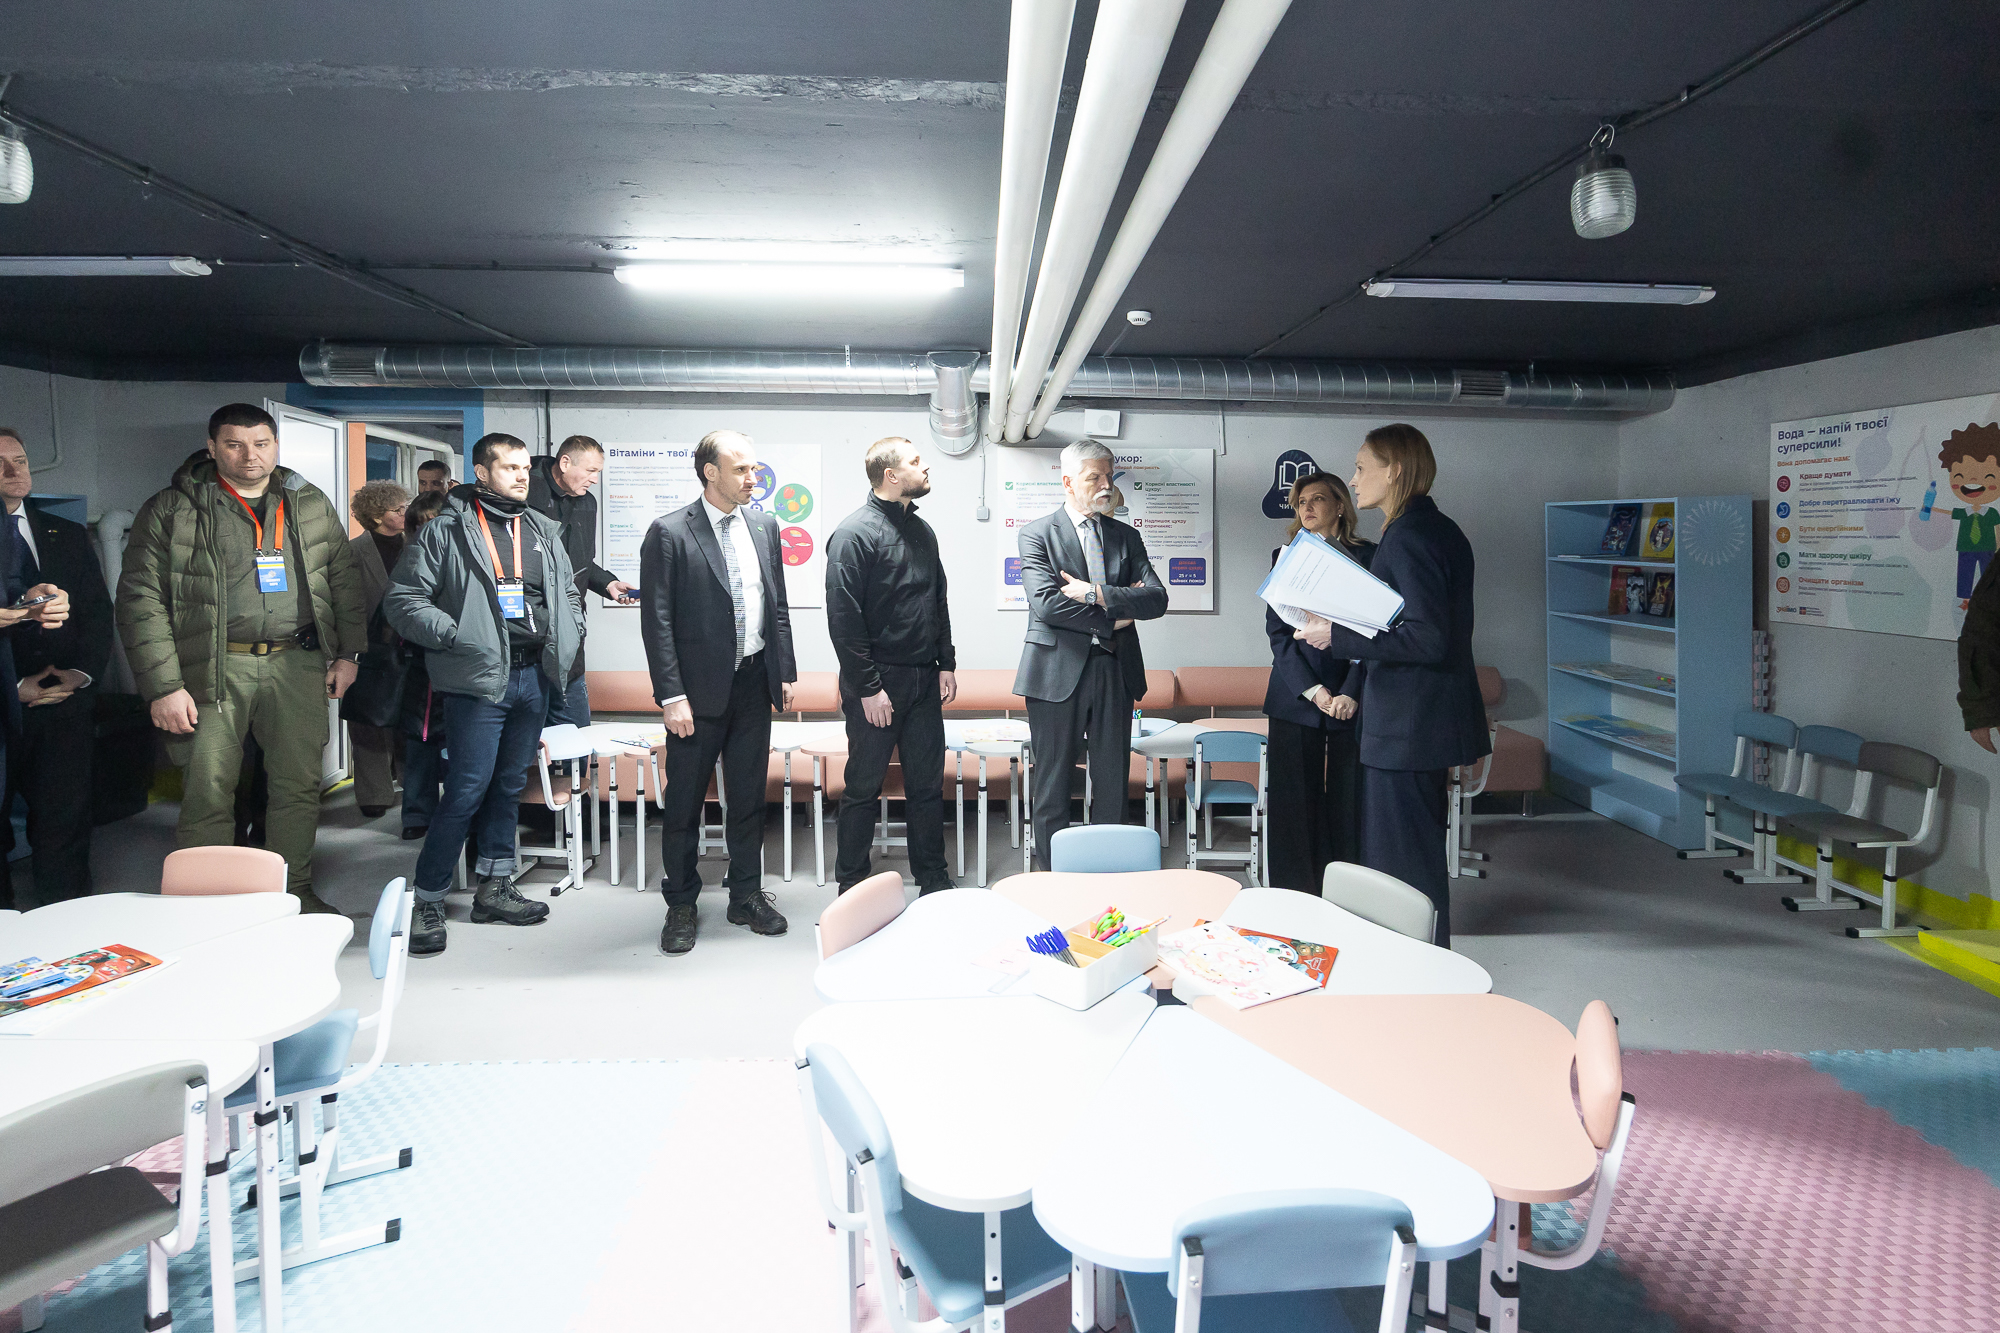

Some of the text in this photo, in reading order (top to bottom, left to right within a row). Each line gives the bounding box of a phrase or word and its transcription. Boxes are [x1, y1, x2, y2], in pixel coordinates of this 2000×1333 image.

[1778, 429, 1804, 440] Вода
[1819, 421, 1851, 435] напій
[1855, 416, 1889, 431] твоєї
[1777, 437, 1841, 454] суперсили!
[609, 448, 655, 457] Вітаміни
[666, 449, 689, 457] твої
[1114, 455, 1143, 464] укор:
[1799, 471, 1852, 480] Краще думати
[1799, 500, 1822, 508] Добре
[1799, 551, 1817, 559] Мати
[1818, 552, 1848, 561] здорову
